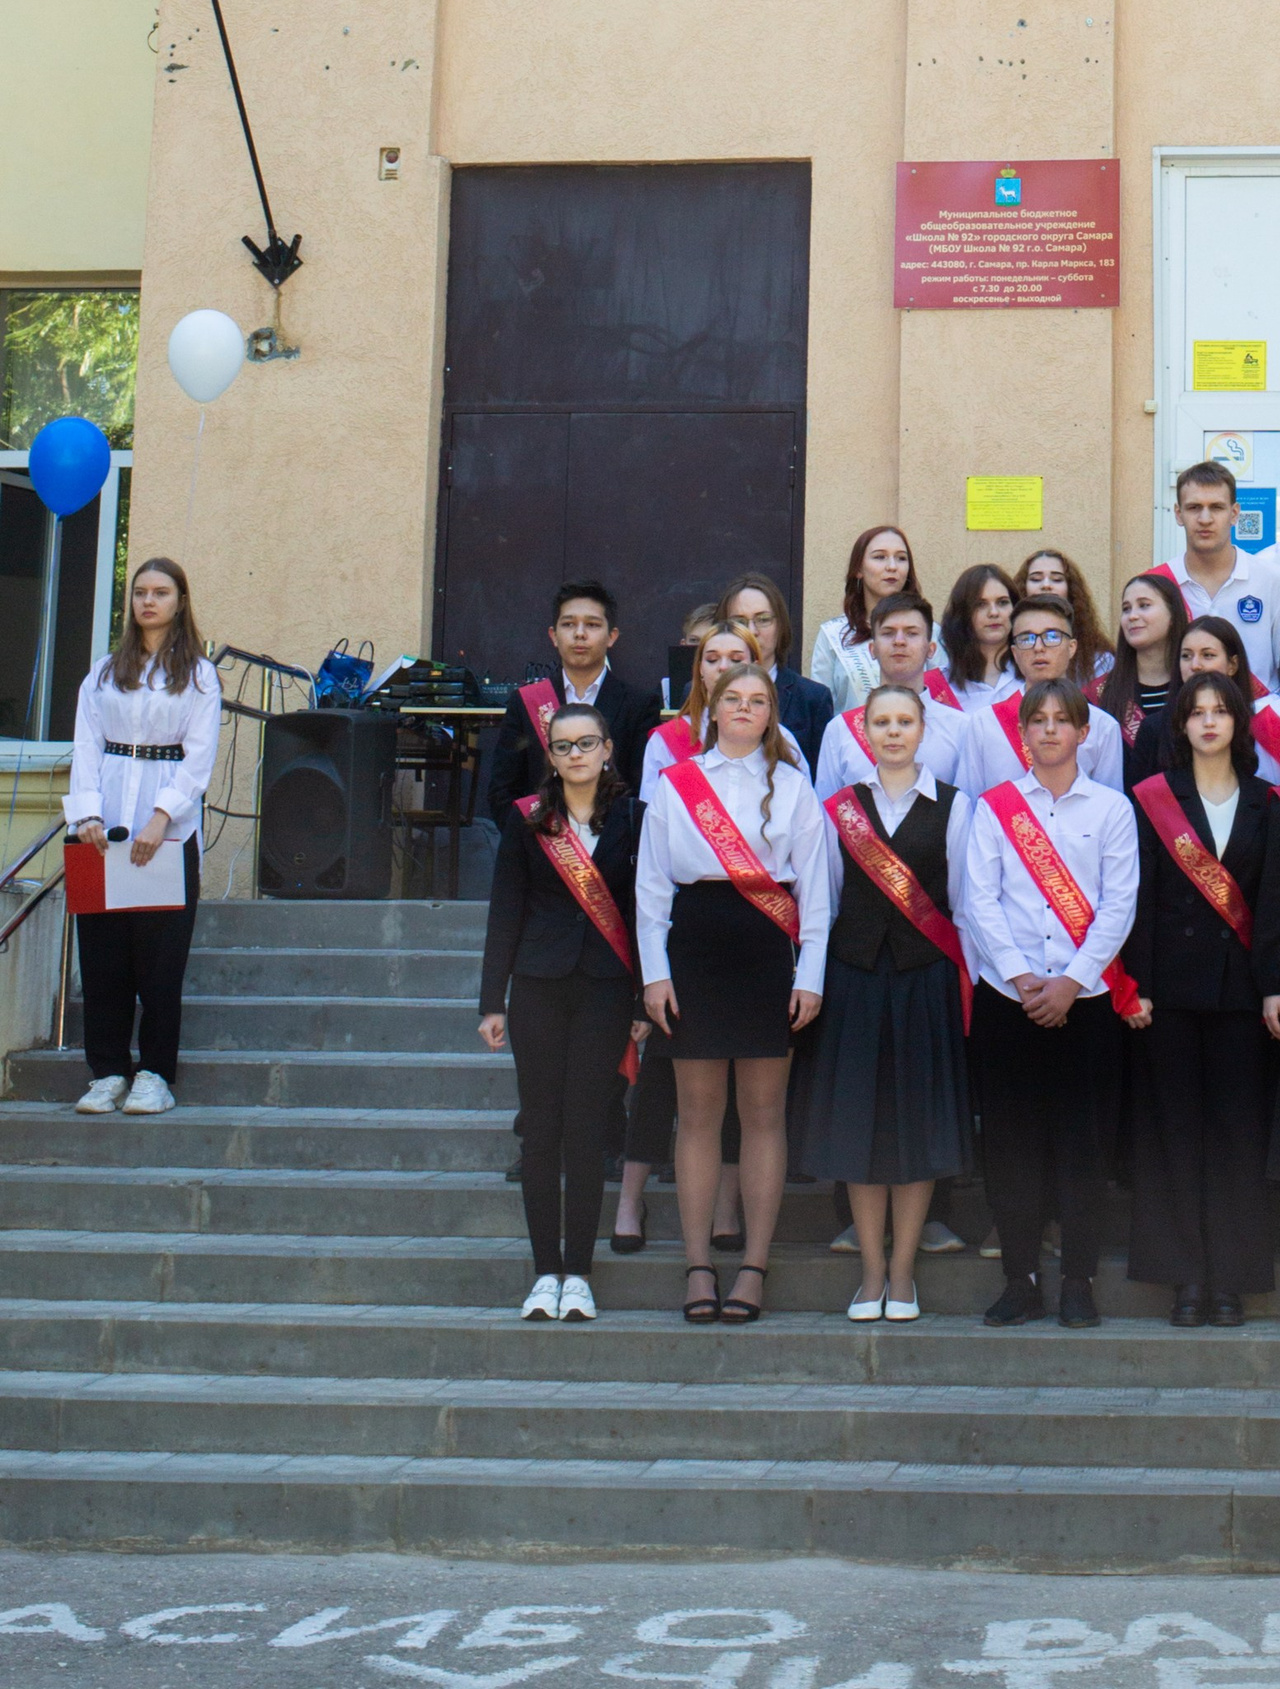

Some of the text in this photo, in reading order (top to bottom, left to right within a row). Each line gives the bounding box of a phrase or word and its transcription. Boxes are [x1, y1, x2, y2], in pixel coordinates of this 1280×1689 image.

[939, 209, 1078, 221] Муниципальное бюджетное
[920, 220, 1096, 231] общеобразовательное учреждение
[905, 231, 1113, 243] «Школа № 92» городского округа Самара
[929, 244, 961, 254] (МБОУ
[963, 244, 996, 253] Школа
[998, 243, 1010, 252] №
[1012, 243, 1025, 252] 92
[1045, 242, 1087, 254] Самара)
[900, 261, 929, 270] адрес:
[930, 260, 968, 269] 443080,
[978, 260, 1014, 270] Самара,
[1016, 261, 1030, 269] пр.
[1031, 259, 1059, 269] Карла
[1060, 259, 1097, 269] Маркса,
[1099, 258, 1115, 267] 183
[921, 275, 951, 284] режим
[952, 274, 989, 284] работы:
[990, 274, 1050, 283] понедельник
[1057, 273, 1094, 283] суббота
[980, 284, 1000, 292] 7.30
[1003, 285, 1015, 293] до
[1016, 284, 1042, 292] 20.00
[952, 295, 1010, 303] воскресенье
[1017, 294, 1062, 303] выходной
